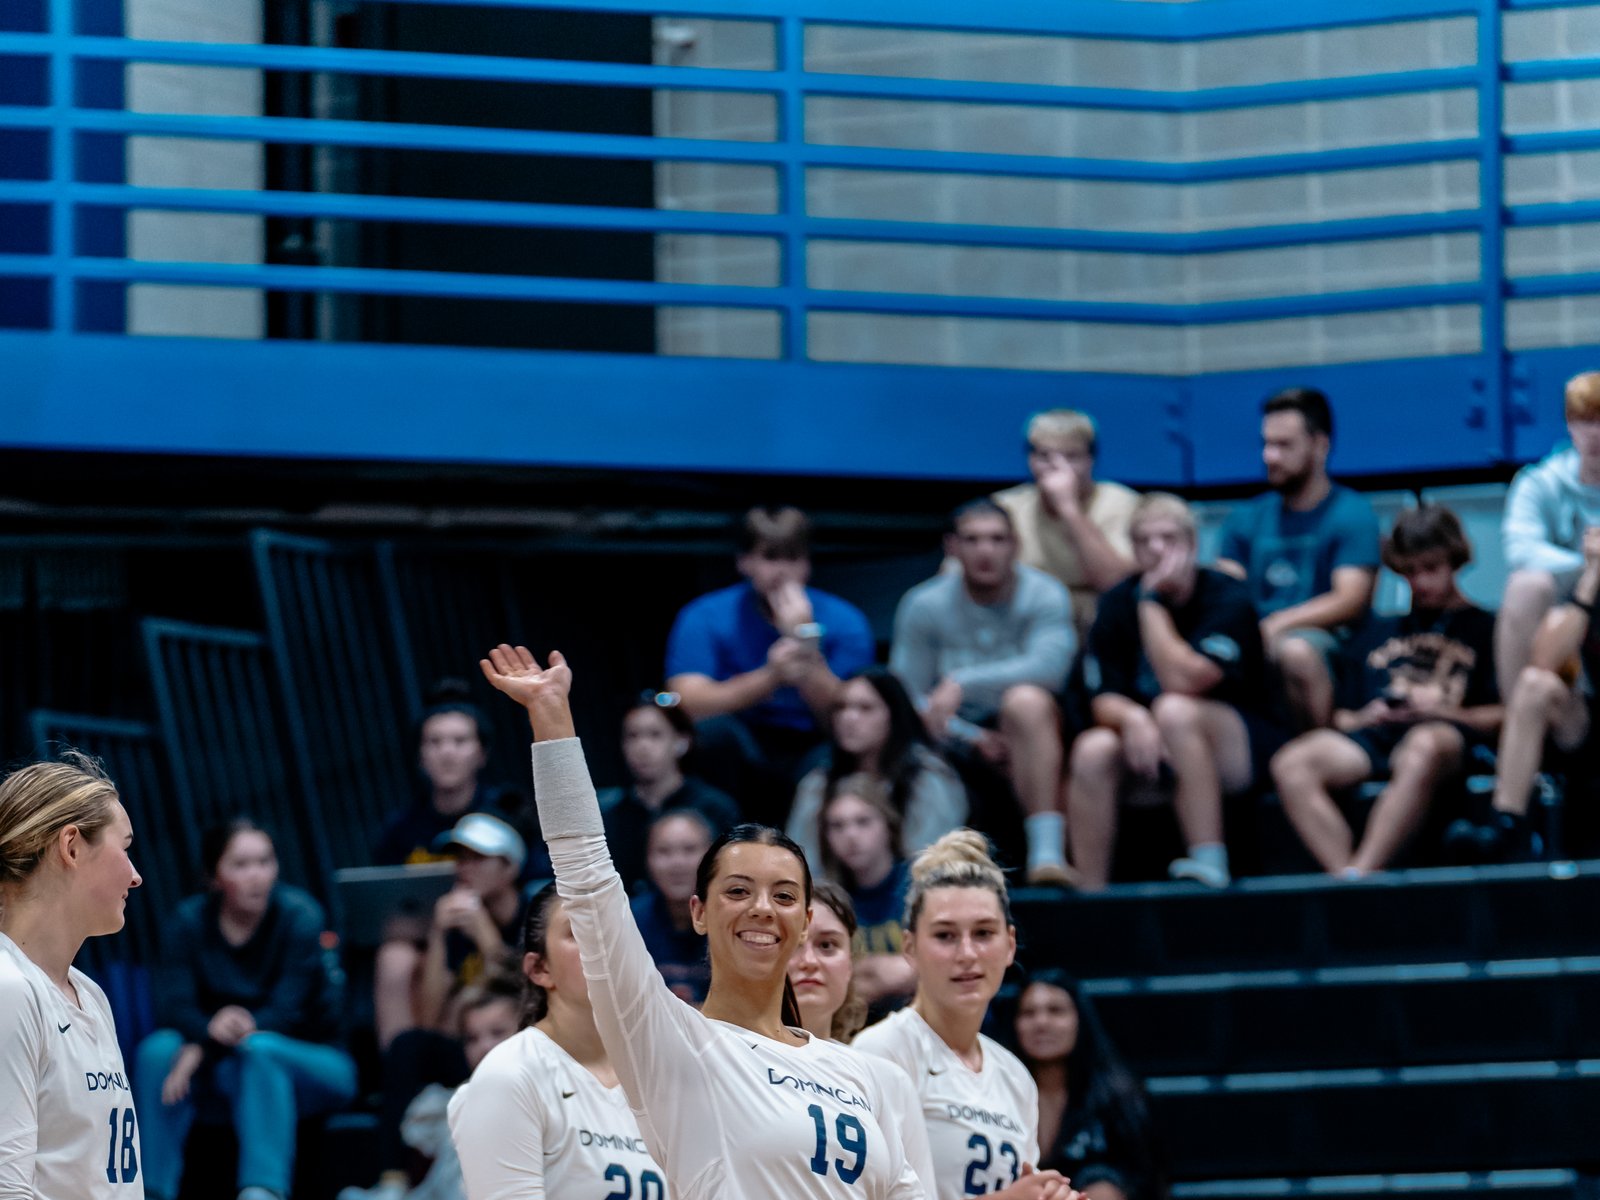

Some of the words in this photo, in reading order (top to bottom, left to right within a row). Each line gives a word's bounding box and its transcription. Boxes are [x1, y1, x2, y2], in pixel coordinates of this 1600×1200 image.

[107, 1107, 138, 1183] 18
[808, 1103, 867, 1185] 19
[964, 1132, 1018, 1195] 23
